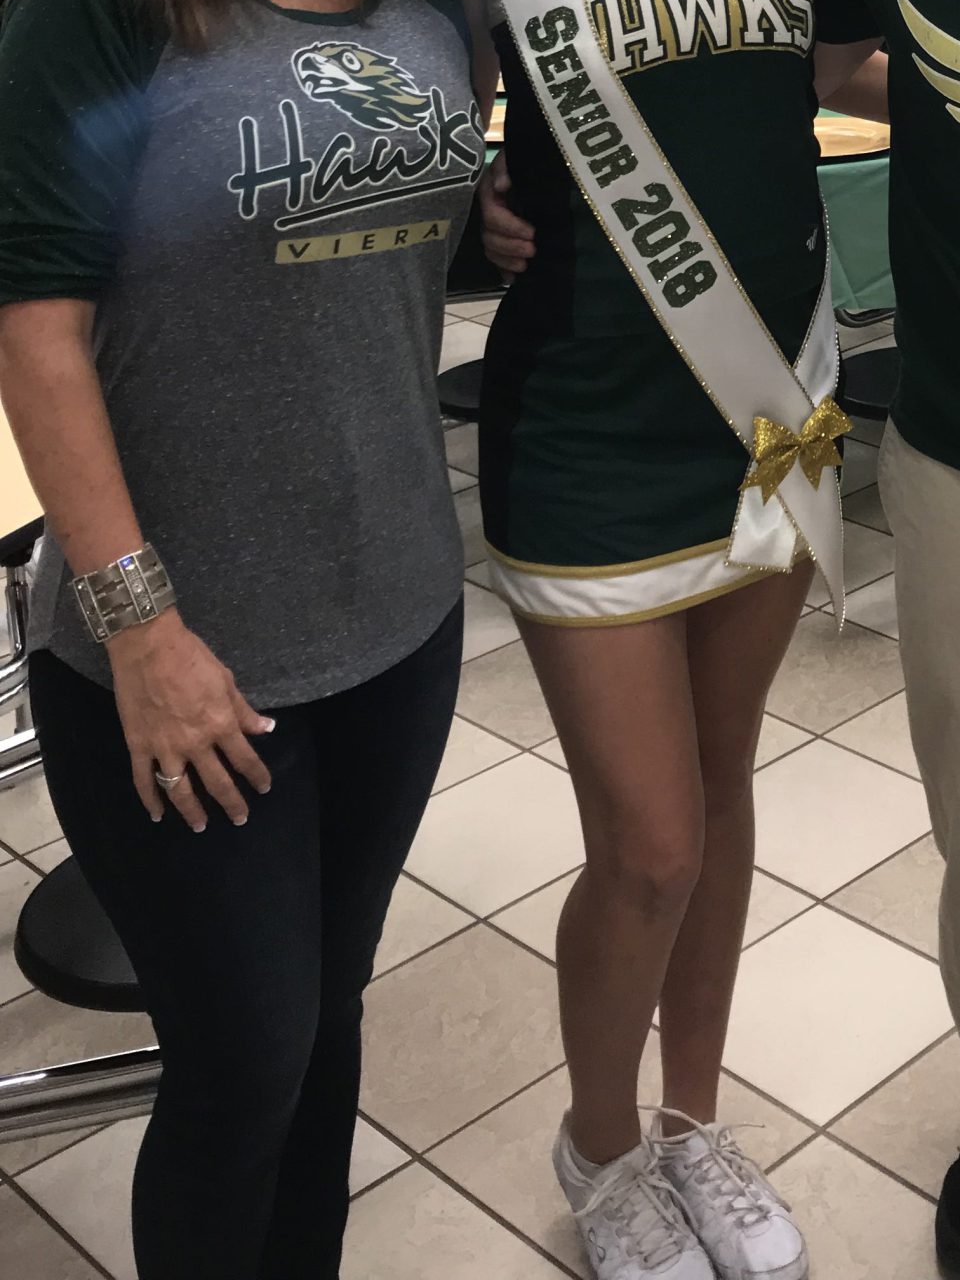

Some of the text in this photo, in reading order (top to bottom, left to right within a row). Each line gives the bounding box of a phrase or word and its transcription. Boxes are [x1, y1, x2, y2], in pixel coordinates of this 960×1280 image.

[287, 223, 440, 259] VIERA
[525, 6, 718, 309] SENIOR 2018
